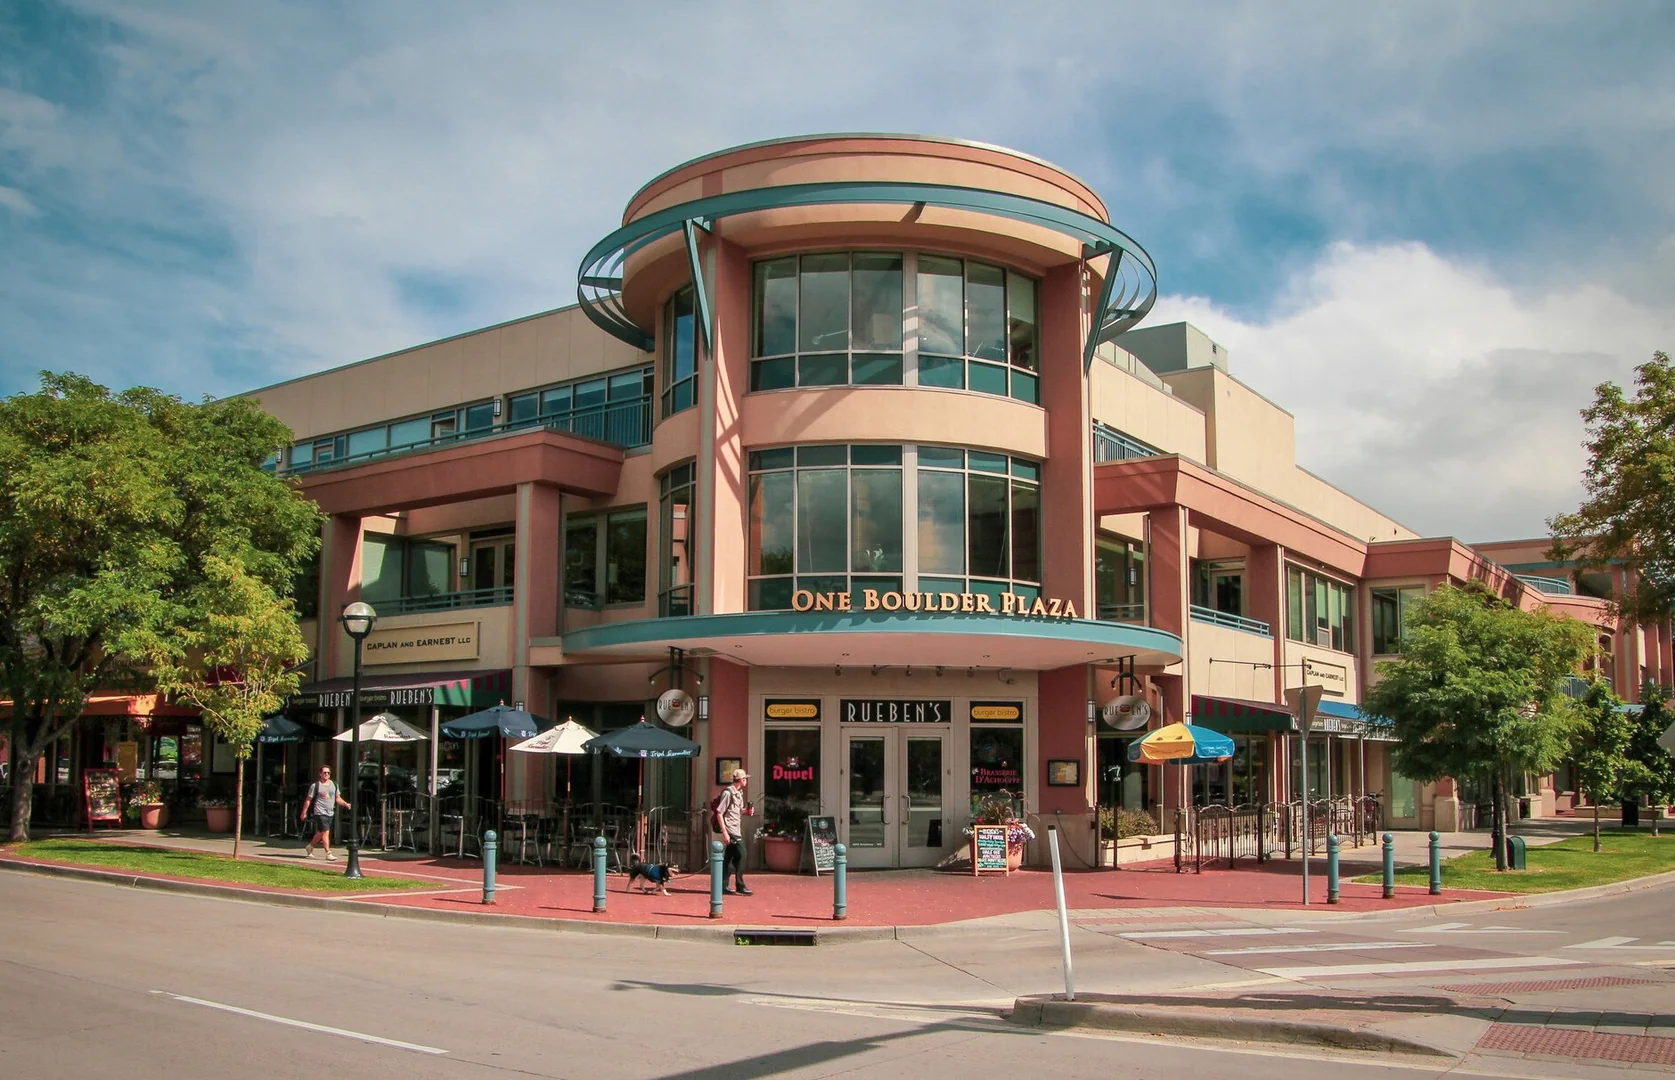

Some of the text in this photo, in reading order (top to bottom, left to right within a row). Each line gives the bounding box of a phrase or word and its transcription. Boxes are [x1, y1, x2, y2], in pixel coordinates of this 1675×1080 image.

[791, 589, 1078, 618] ONE BOULDER PLAZA
[367, 641, 398, 650] CAPLAN
[416, 637, 456, 647] EARNEST
[319, 692, 354, 707] RUEBEN'
[391, 689, 433, 705] RUEBEN'S
[769, 706, 815, 716] burger bistro
[848, 702, 941, 722] RUEBEN'S
[973, 709, 995, 717] burger
[772, 765, 814, 781] Duvel
